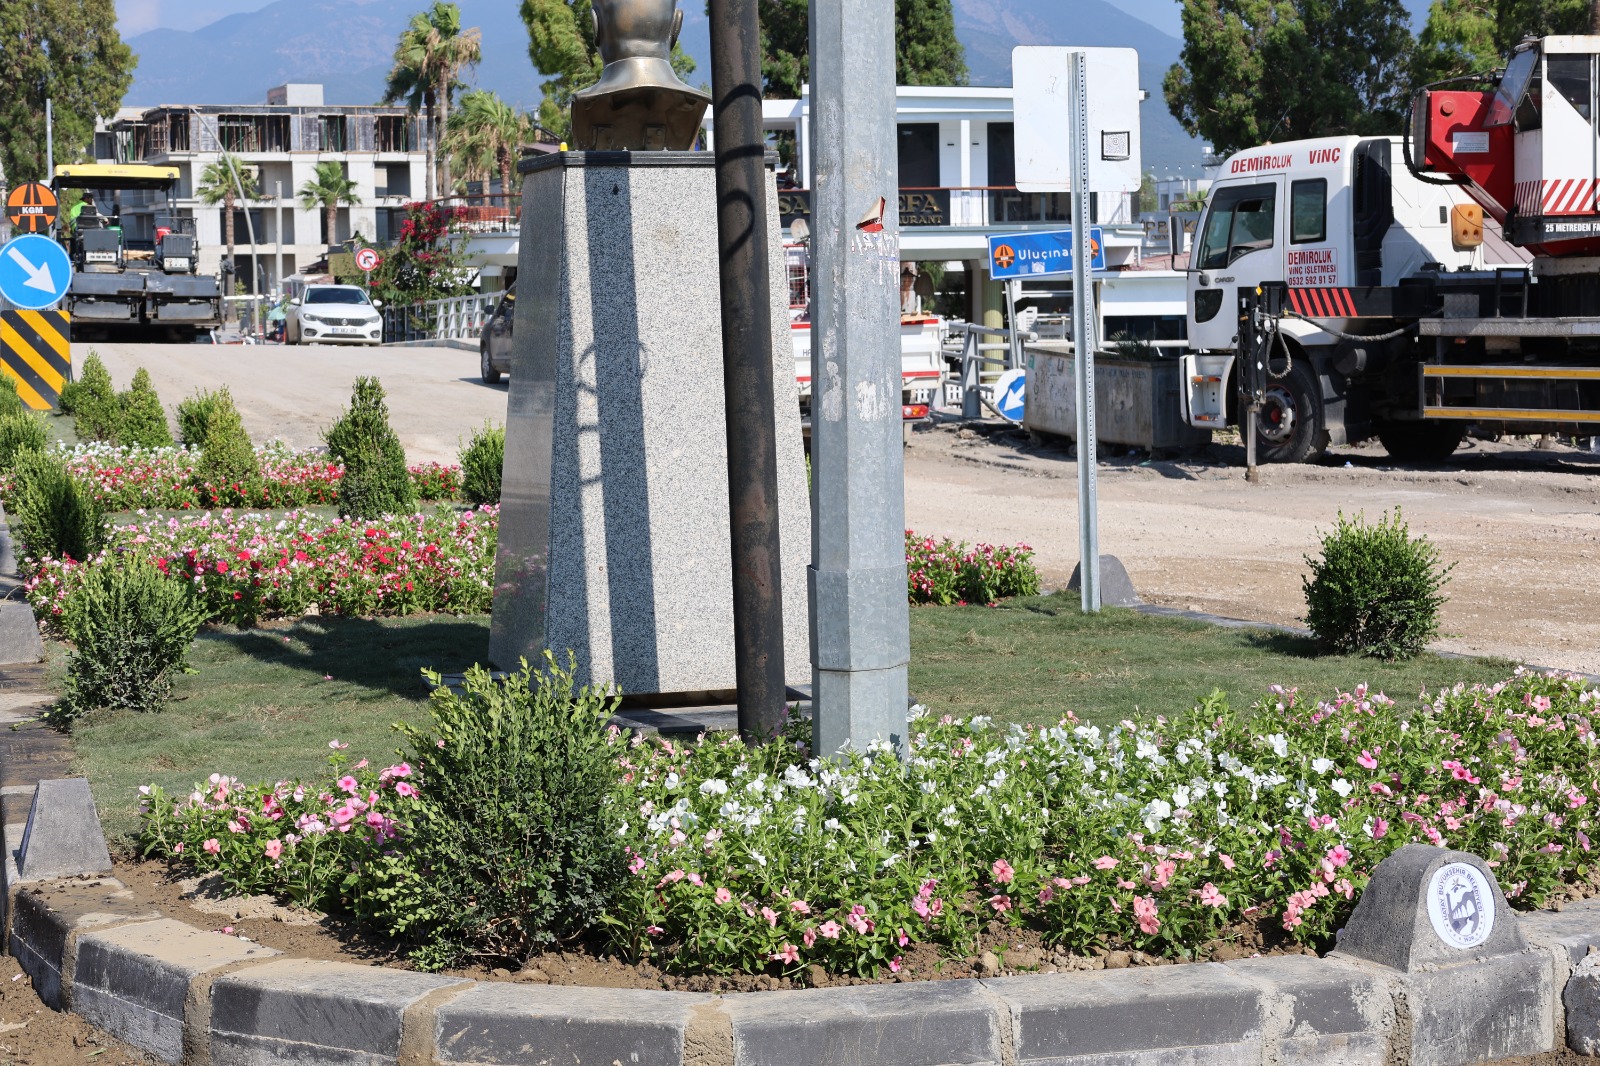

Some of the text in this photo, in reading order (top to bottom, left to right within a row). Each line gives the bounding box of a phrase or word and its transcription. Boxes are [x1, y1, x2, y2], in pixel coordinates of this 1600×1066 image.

[1545, 224, 1554, 232] 25
[1555, 223, 1591, 232] METREDEN
[1289, 274, 1336, 286] 0532 592 91 57
[1439, 898, 1448, 921] HATAY
